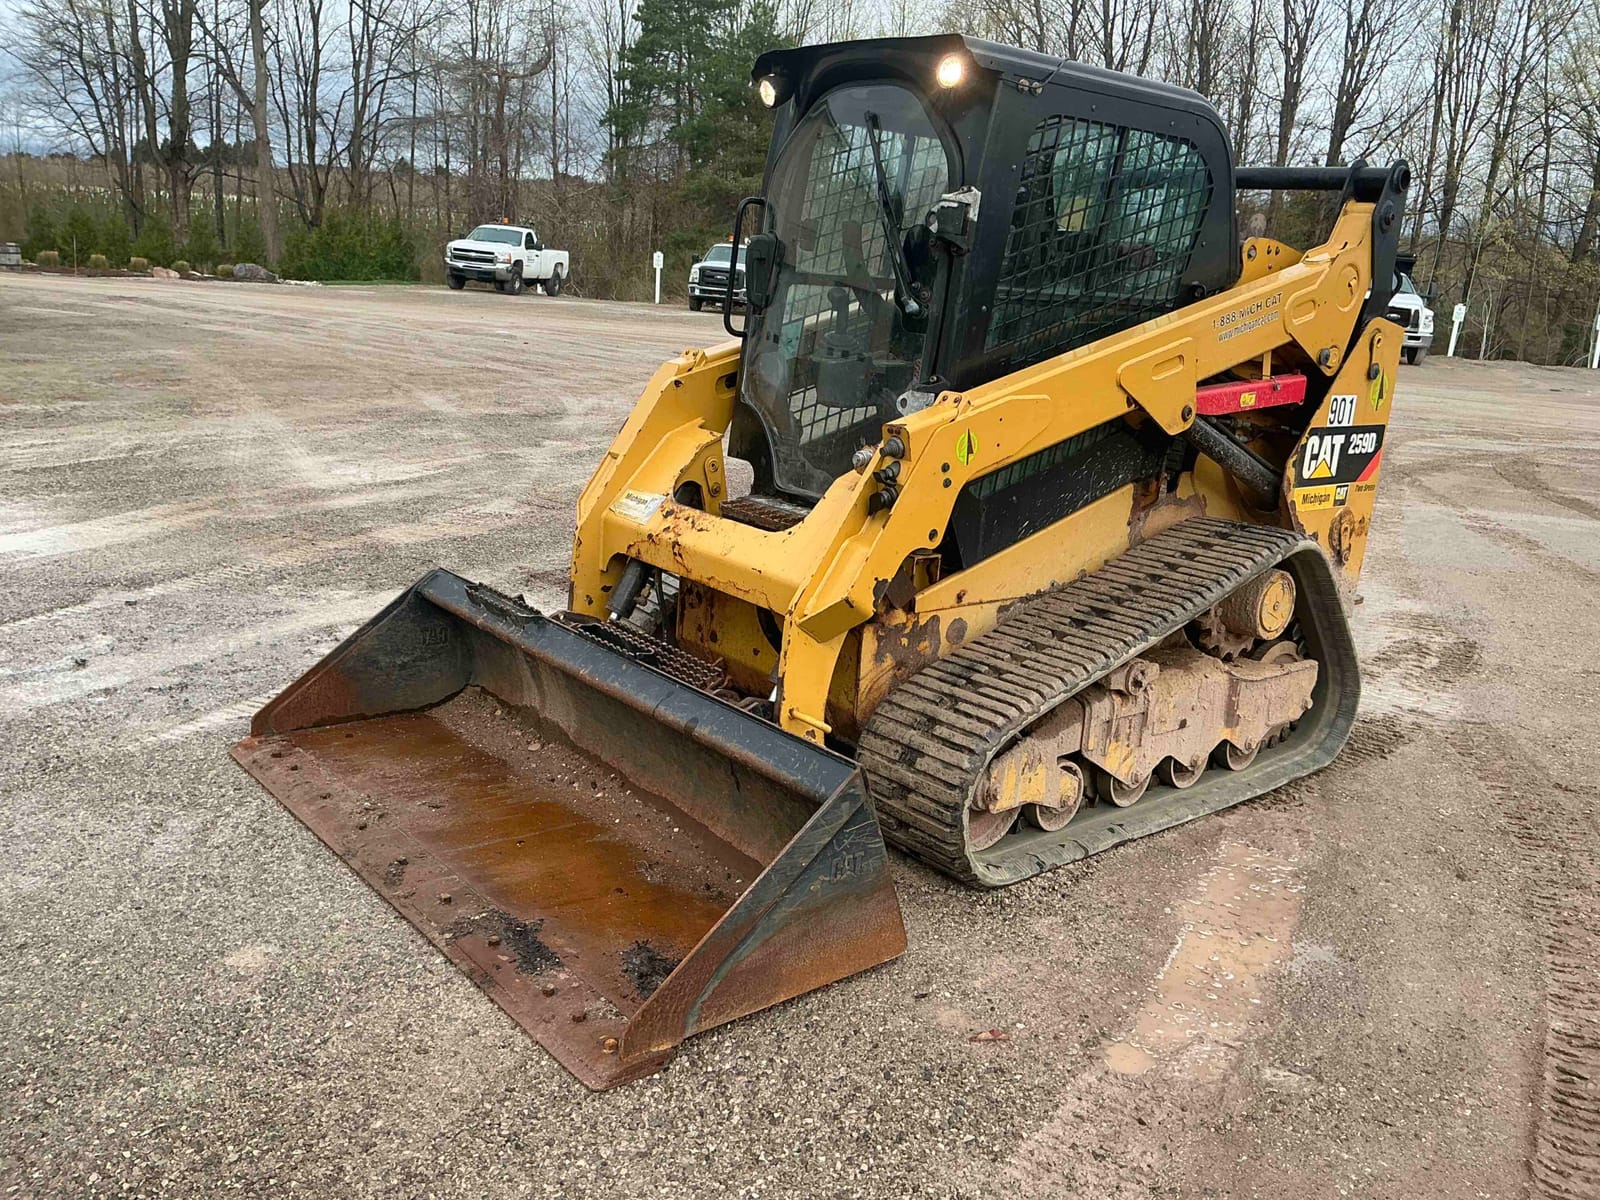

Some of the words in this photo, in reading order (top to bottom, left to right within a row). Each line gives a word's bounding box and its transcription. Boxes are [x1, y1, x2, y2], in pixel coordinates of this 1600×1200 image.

[1265, 293, 1282, 309] CAT
[1328, 397, 1355, 425] 901
[1302, 434, 1346, 480] CAT
[1347, 432, 1377, 455] 259D
[1301, 492, 1331, 506] Michigan
